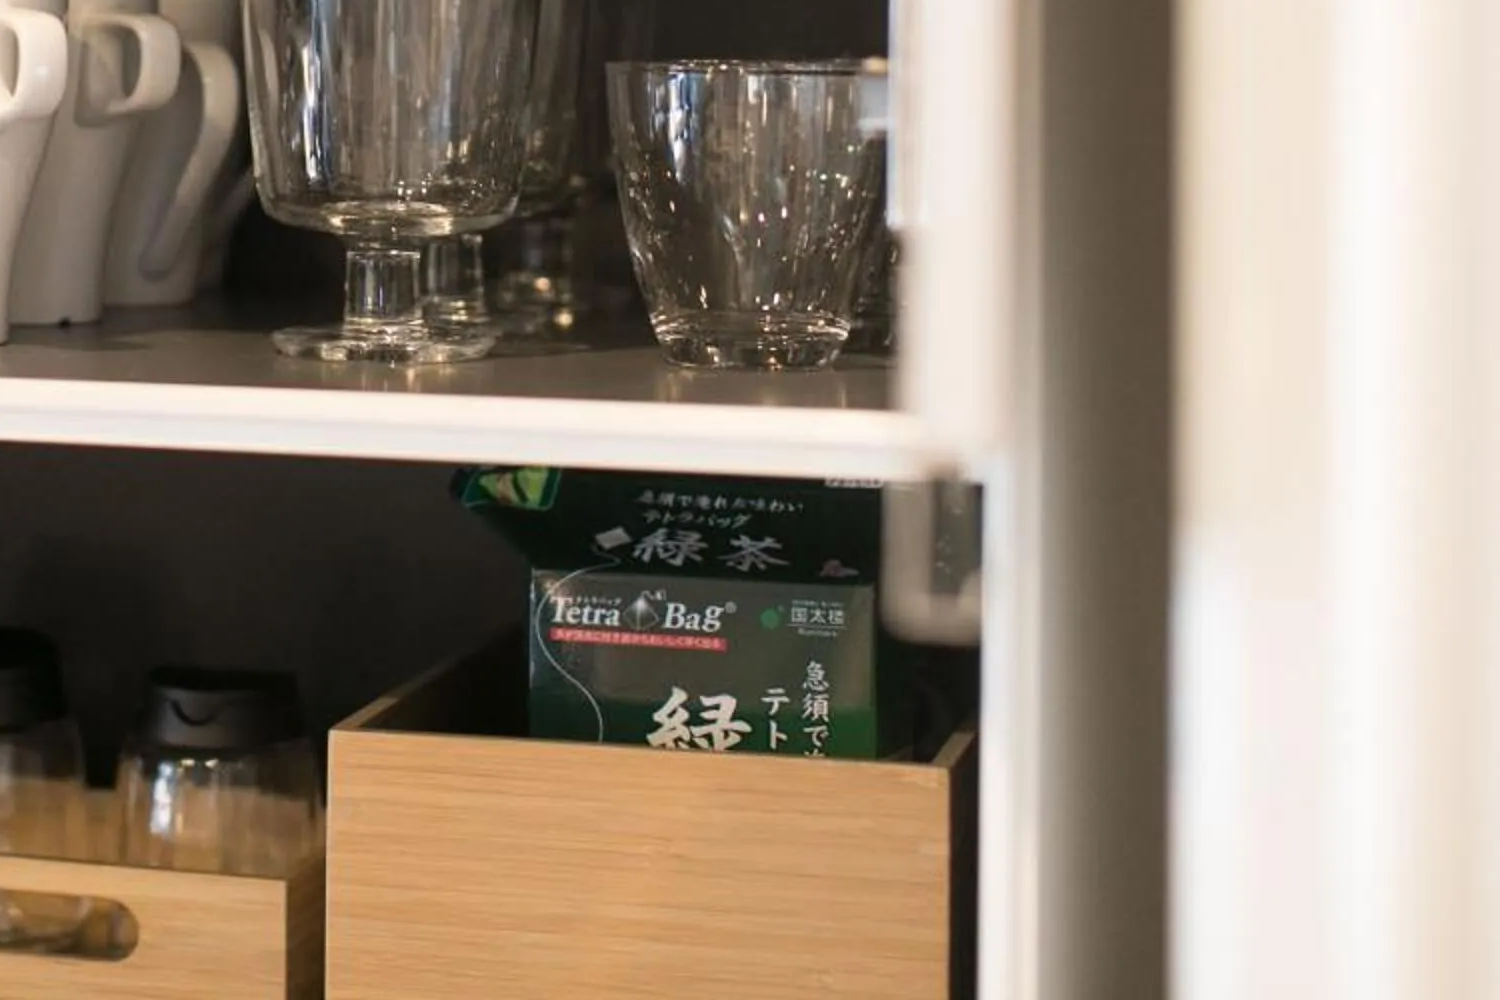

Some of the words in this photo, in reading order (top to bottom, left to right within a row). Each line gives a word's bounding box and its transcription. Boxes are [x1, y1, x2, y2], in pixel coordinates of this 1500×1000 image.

[632, 529, 792, 572] 緑茶
[552, 597, 621, 626] Tetra
[646, 687, 752, 751] 緑
[761, 688, 790, 750] テト
